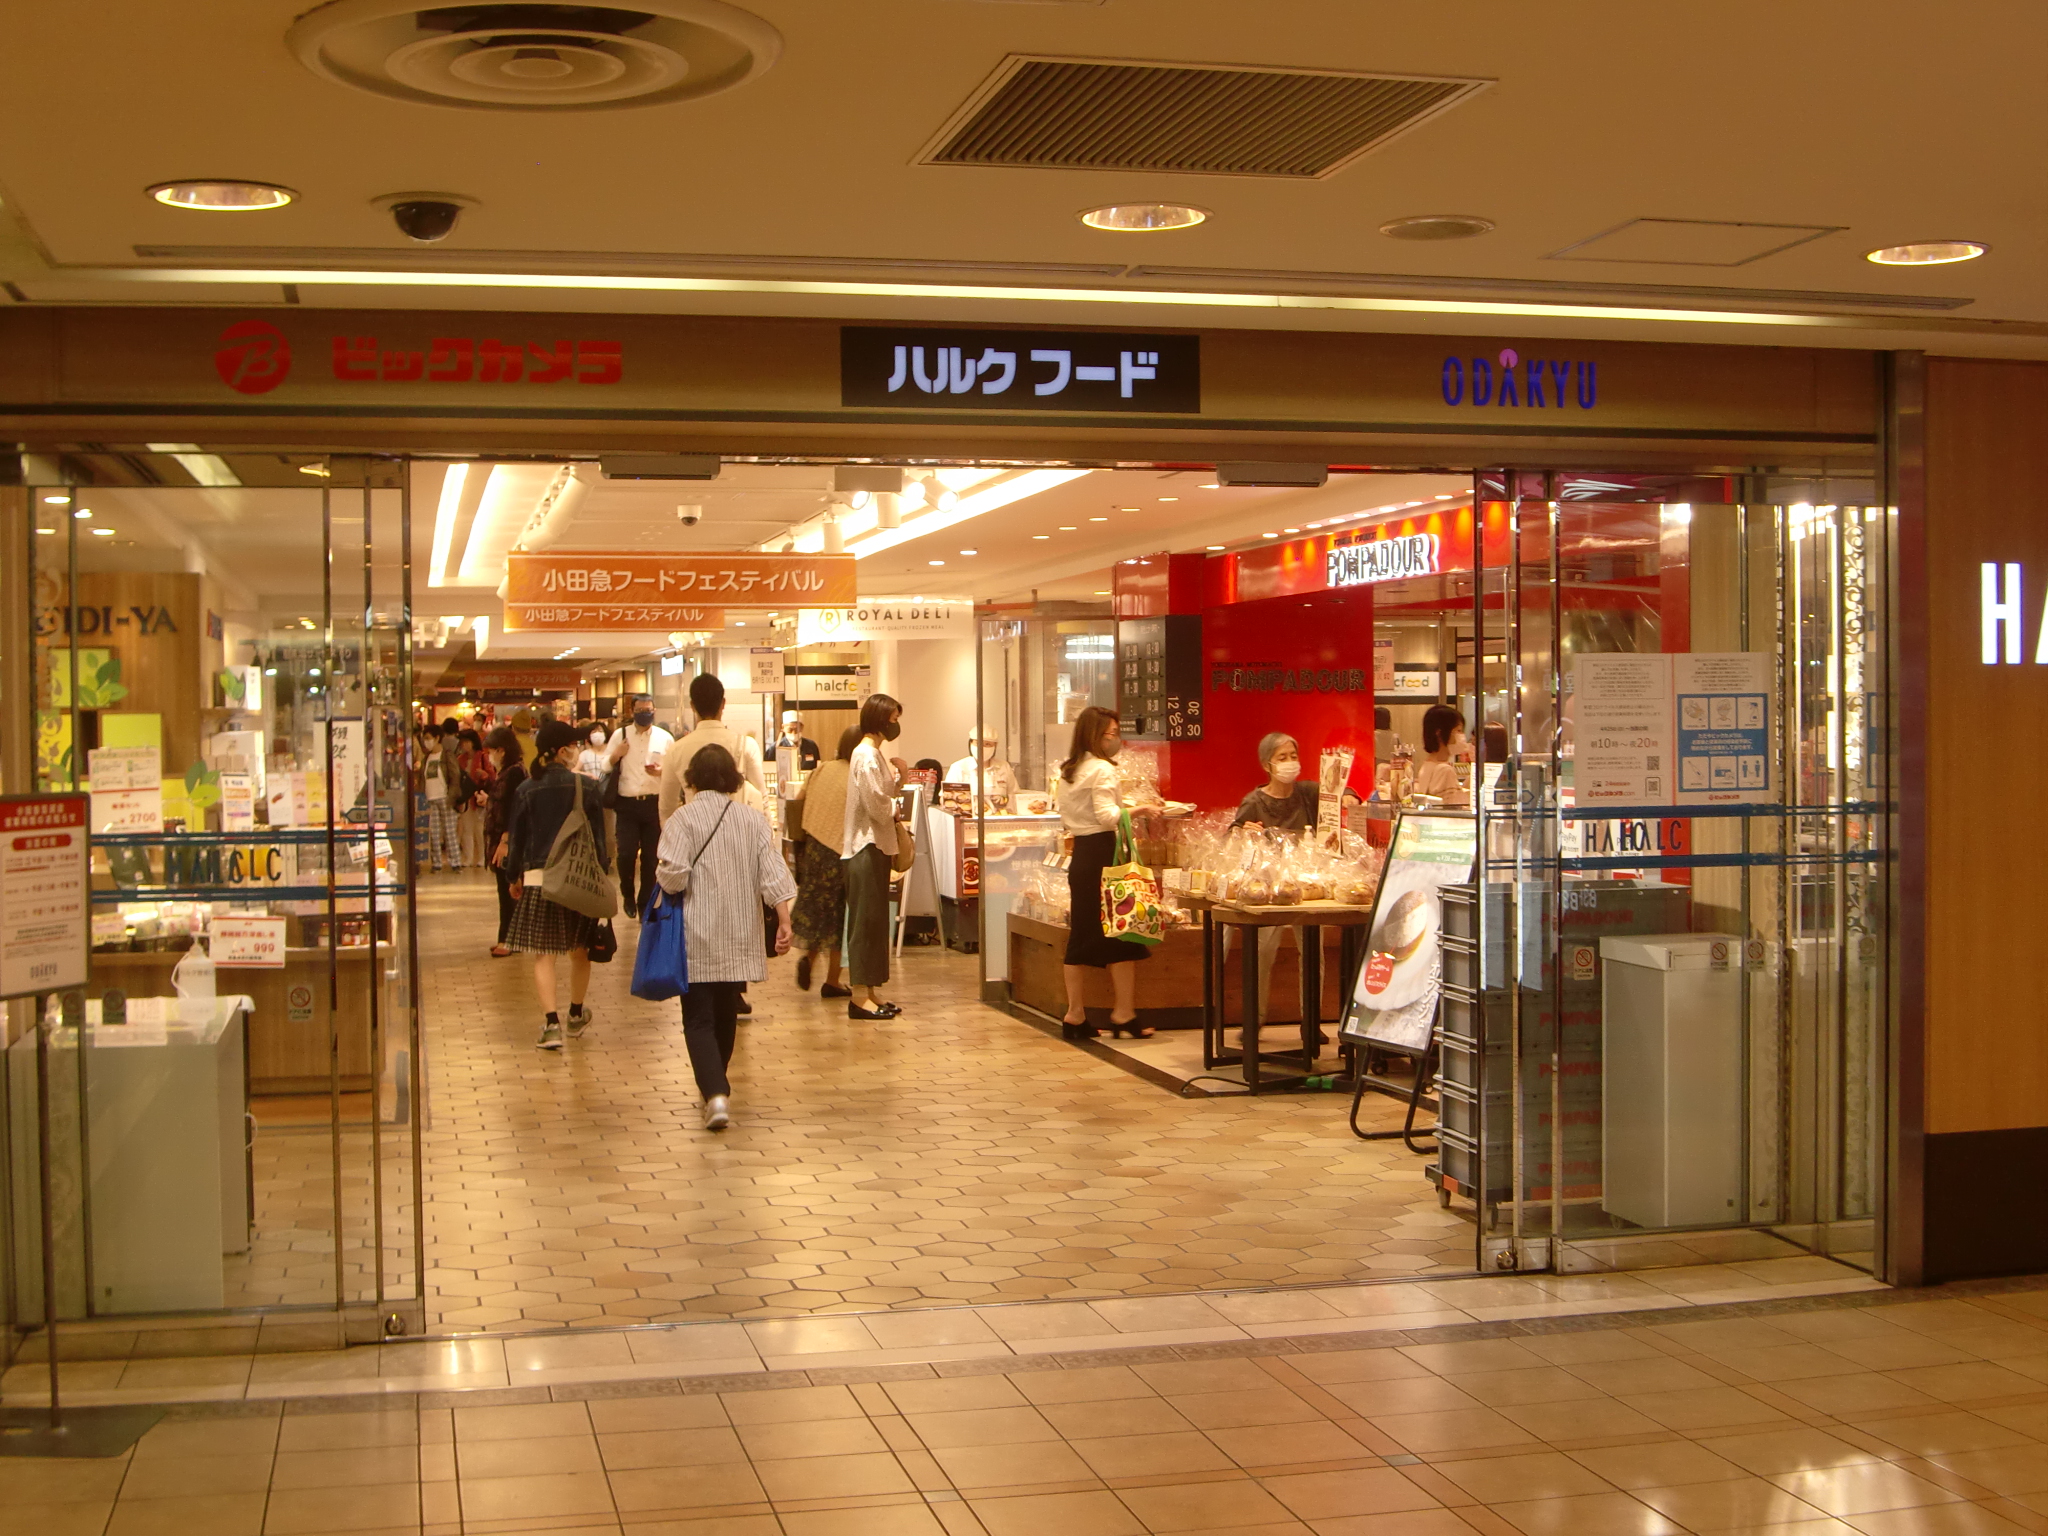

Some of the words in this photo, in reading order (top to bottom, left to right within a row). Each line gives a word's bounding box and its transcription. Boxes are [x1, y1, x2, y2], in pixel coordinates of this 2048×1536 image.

[332, 336, 622, 384] ビックカメラ
[888, 344, 1018, 396] ハルク
[1031, 348, 1160, 399] フード
[1442, 351, 1597, 409] ODAKYU
[1327, 534, 1430, 587] POMPADOUR
[542, 568, 824, 593] 小田急フードフェスティバル
[847, 608, 903, 621] ROYAL
[911, 607, 950, 620] DELI
[1212, 668, 1365, 692] POMPADOUR
[130, 812, 156, 823] 2700
